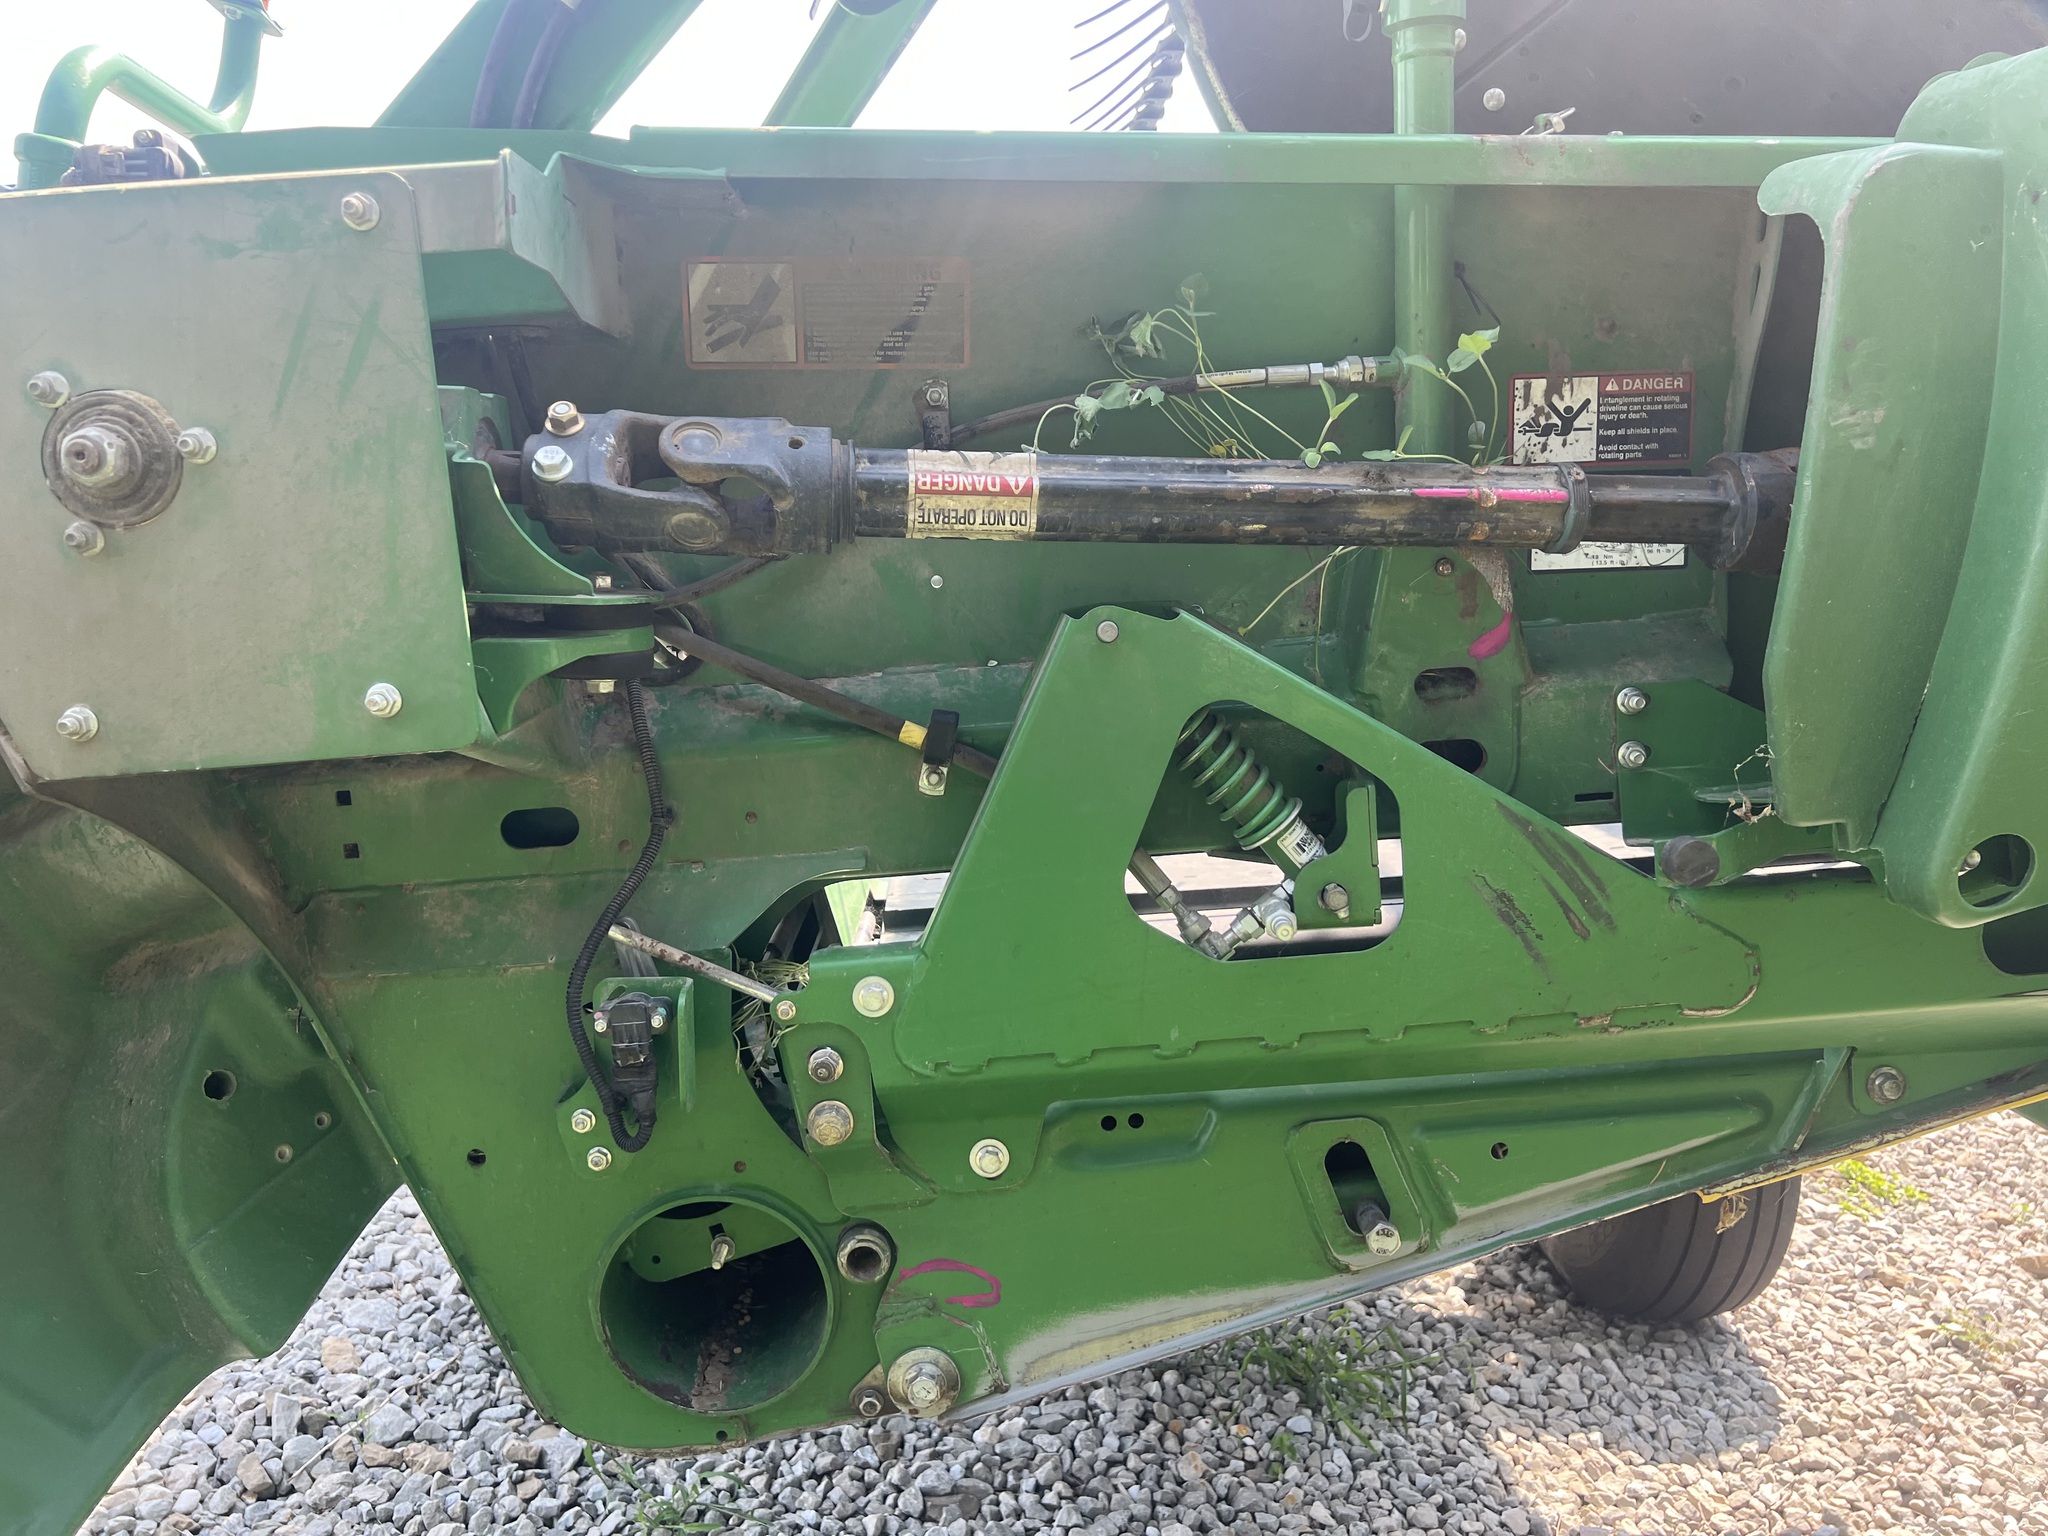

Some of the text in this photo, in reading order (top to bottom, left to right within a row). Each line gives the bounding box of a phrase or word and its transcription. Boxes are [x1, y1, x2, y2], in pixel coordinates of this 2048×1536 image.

[1622, 378, 1684, 391] DANGER
[1599, 404, 1628, 412] driveline
[1598, 428, 1616, 436] Keep
[1598, 452, 1624, 460] rotating
[917, 472, 1000, 492] DANGER
[917, 508, 1028, 527] DO NOT OPERATE
